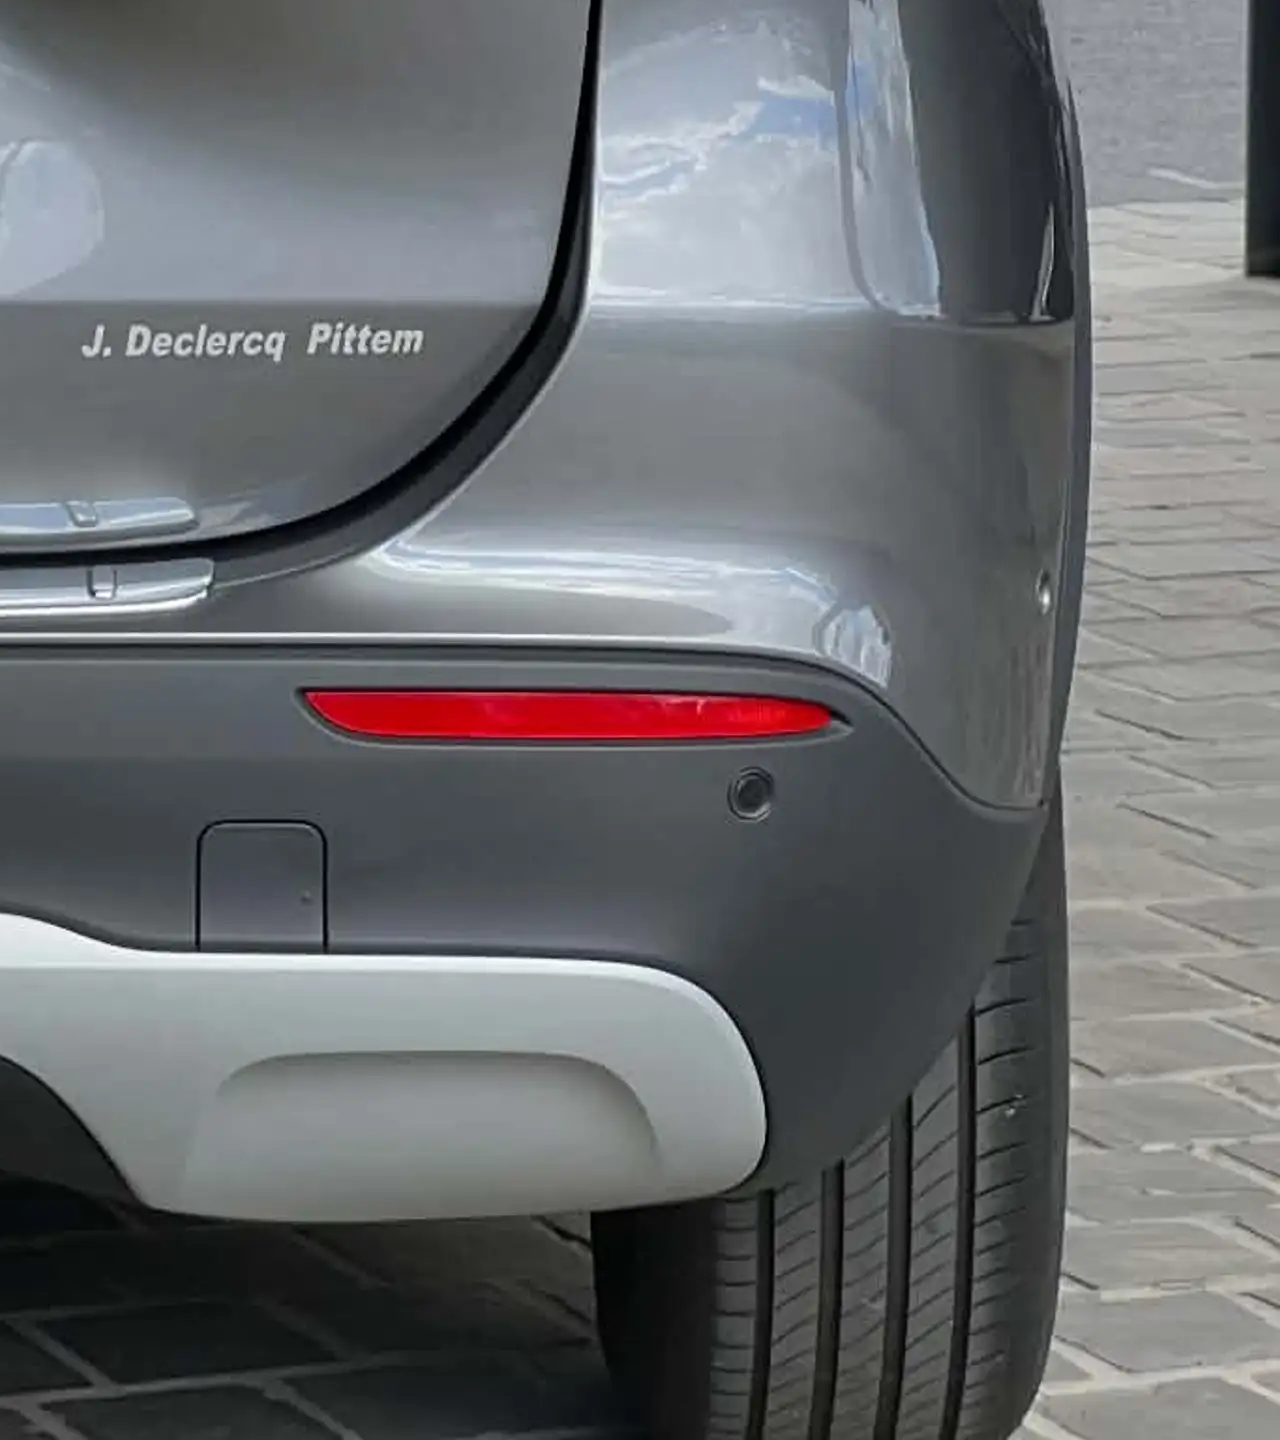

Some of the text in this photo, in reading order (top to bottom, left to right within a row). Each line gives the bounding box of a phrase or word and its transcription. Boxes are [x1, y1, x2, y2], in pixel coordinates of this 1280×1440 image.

[81, 321, 425, 362] J. Declercq Pittem
